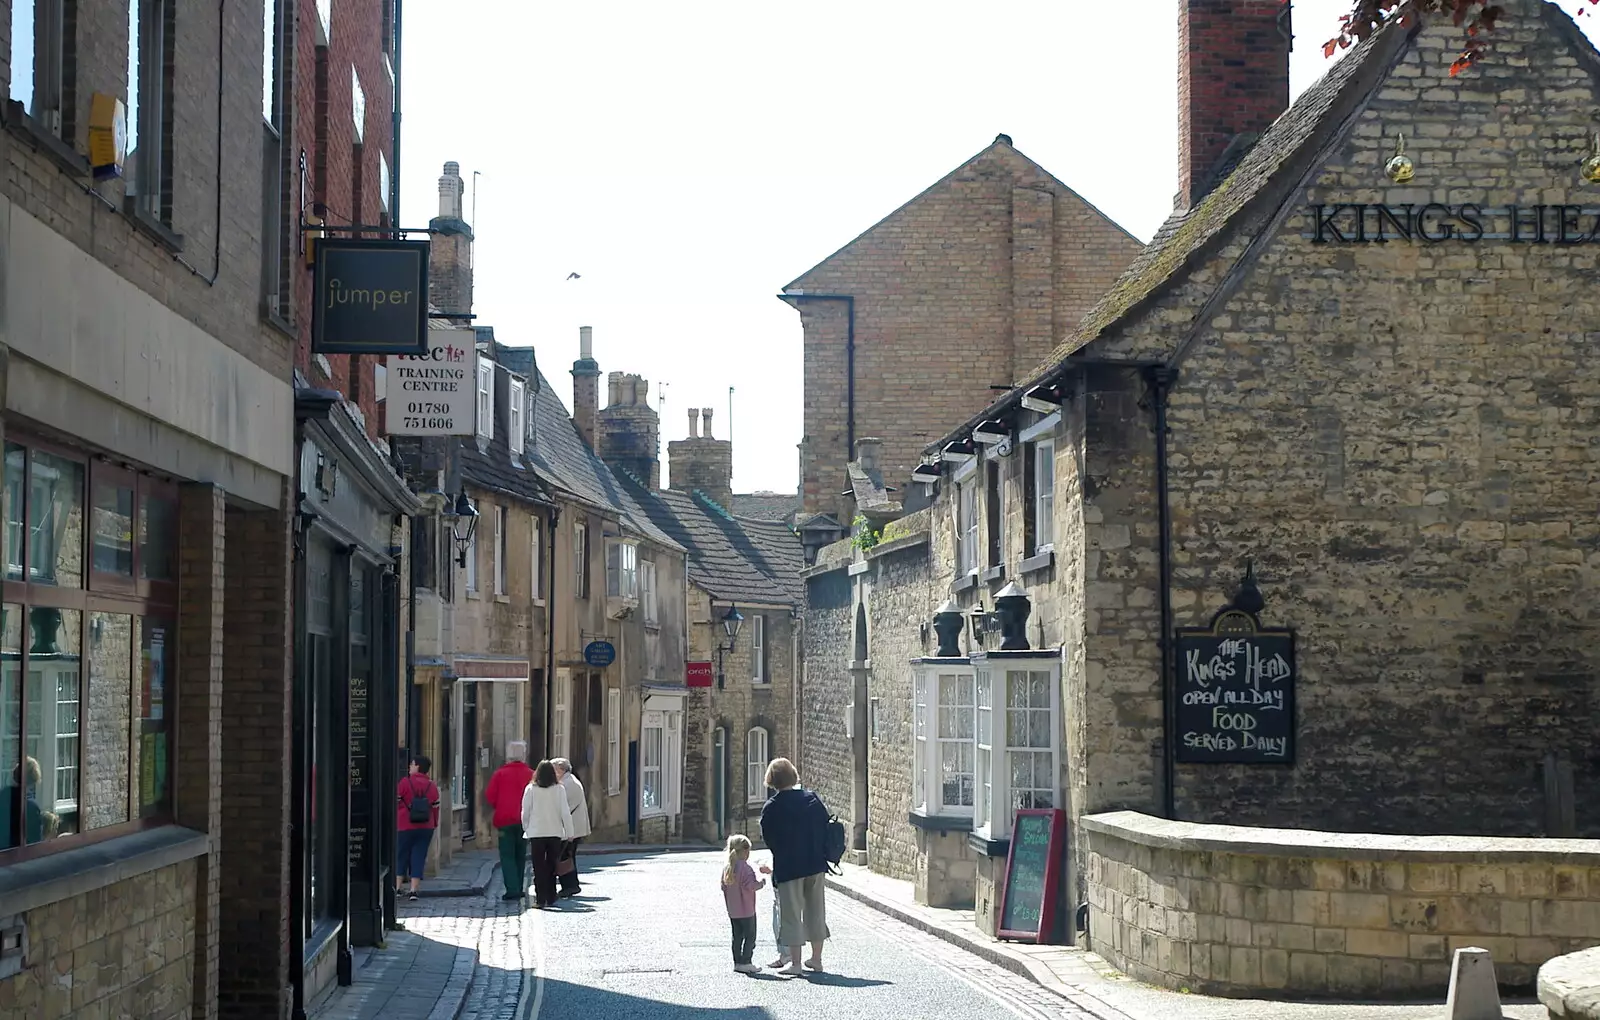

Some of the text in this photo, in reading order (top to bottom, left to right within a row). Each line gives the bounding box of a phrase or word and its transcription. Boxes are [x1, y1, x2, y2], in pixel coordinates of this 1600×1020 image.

[1310, 203, 1600, 244] KINGS HE
[328, 278, 412, 311] jumper
[397, 367, 464, 379] TRAINING
[403, 381, 458, 392] CENTRE
[408, 402, 450, 414] 01780
[404, 417, 453, 429] 751606
[1218, 638, 1246, 657] THE
[1245, 642, 1291, 690] HEAD
[1183, 686, 1284, 710] OPEN ALL DAY
[1212, 705, 1257, 730] FOOD
[1183, 731, 1287, 756] SERVED DAILY
